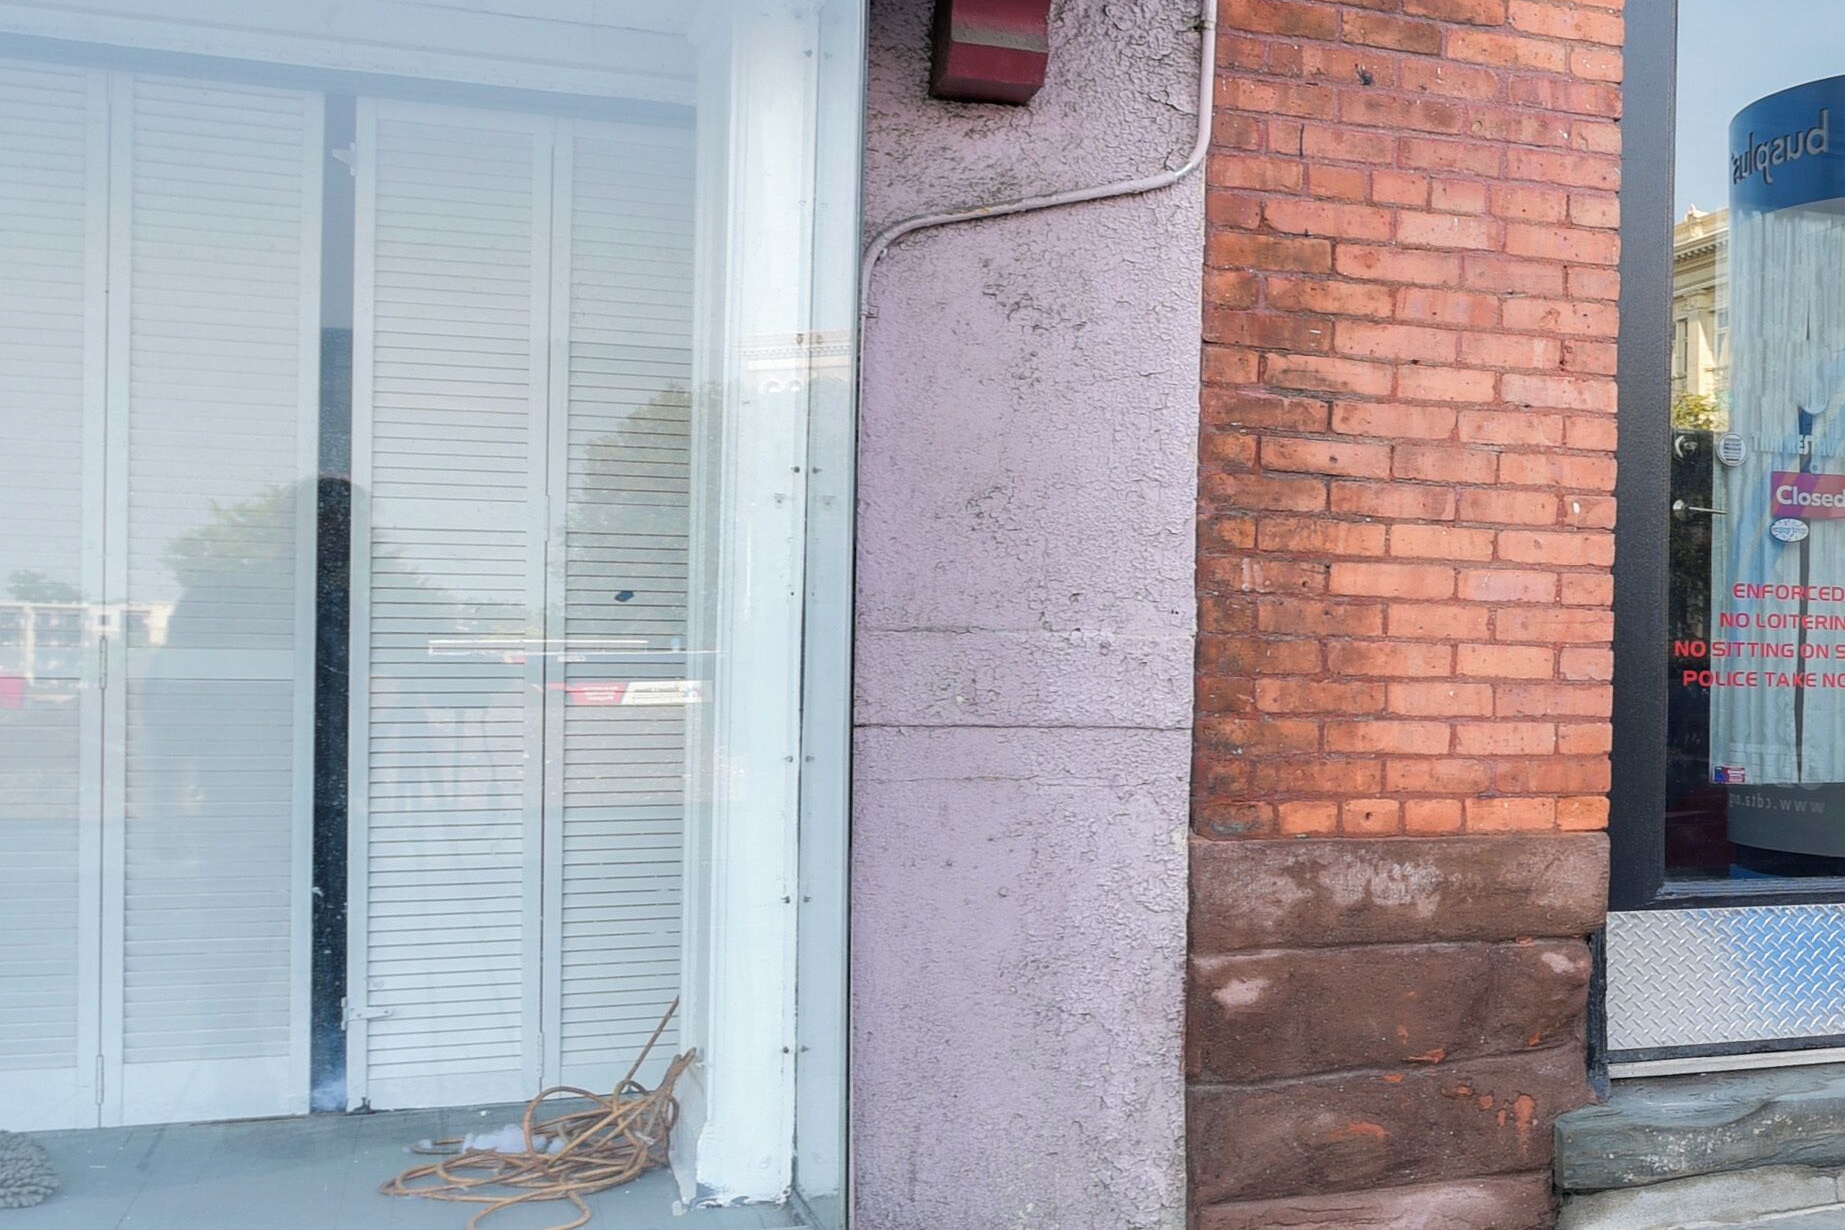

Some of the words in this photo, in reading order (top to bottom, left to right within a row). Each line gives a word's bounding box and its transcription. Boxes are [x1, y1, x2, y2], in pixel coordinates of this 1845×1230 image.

[1719, 612, 1750, 628] NO
[1673, 640, 1706, 658] NO
[1711, 642, 1794, 658] SITTING
[1799, 644, 1829, 659] ON
[1683, 670, 1758, 688] POLICE
[1765, 672, 1817, 688] TAKE
